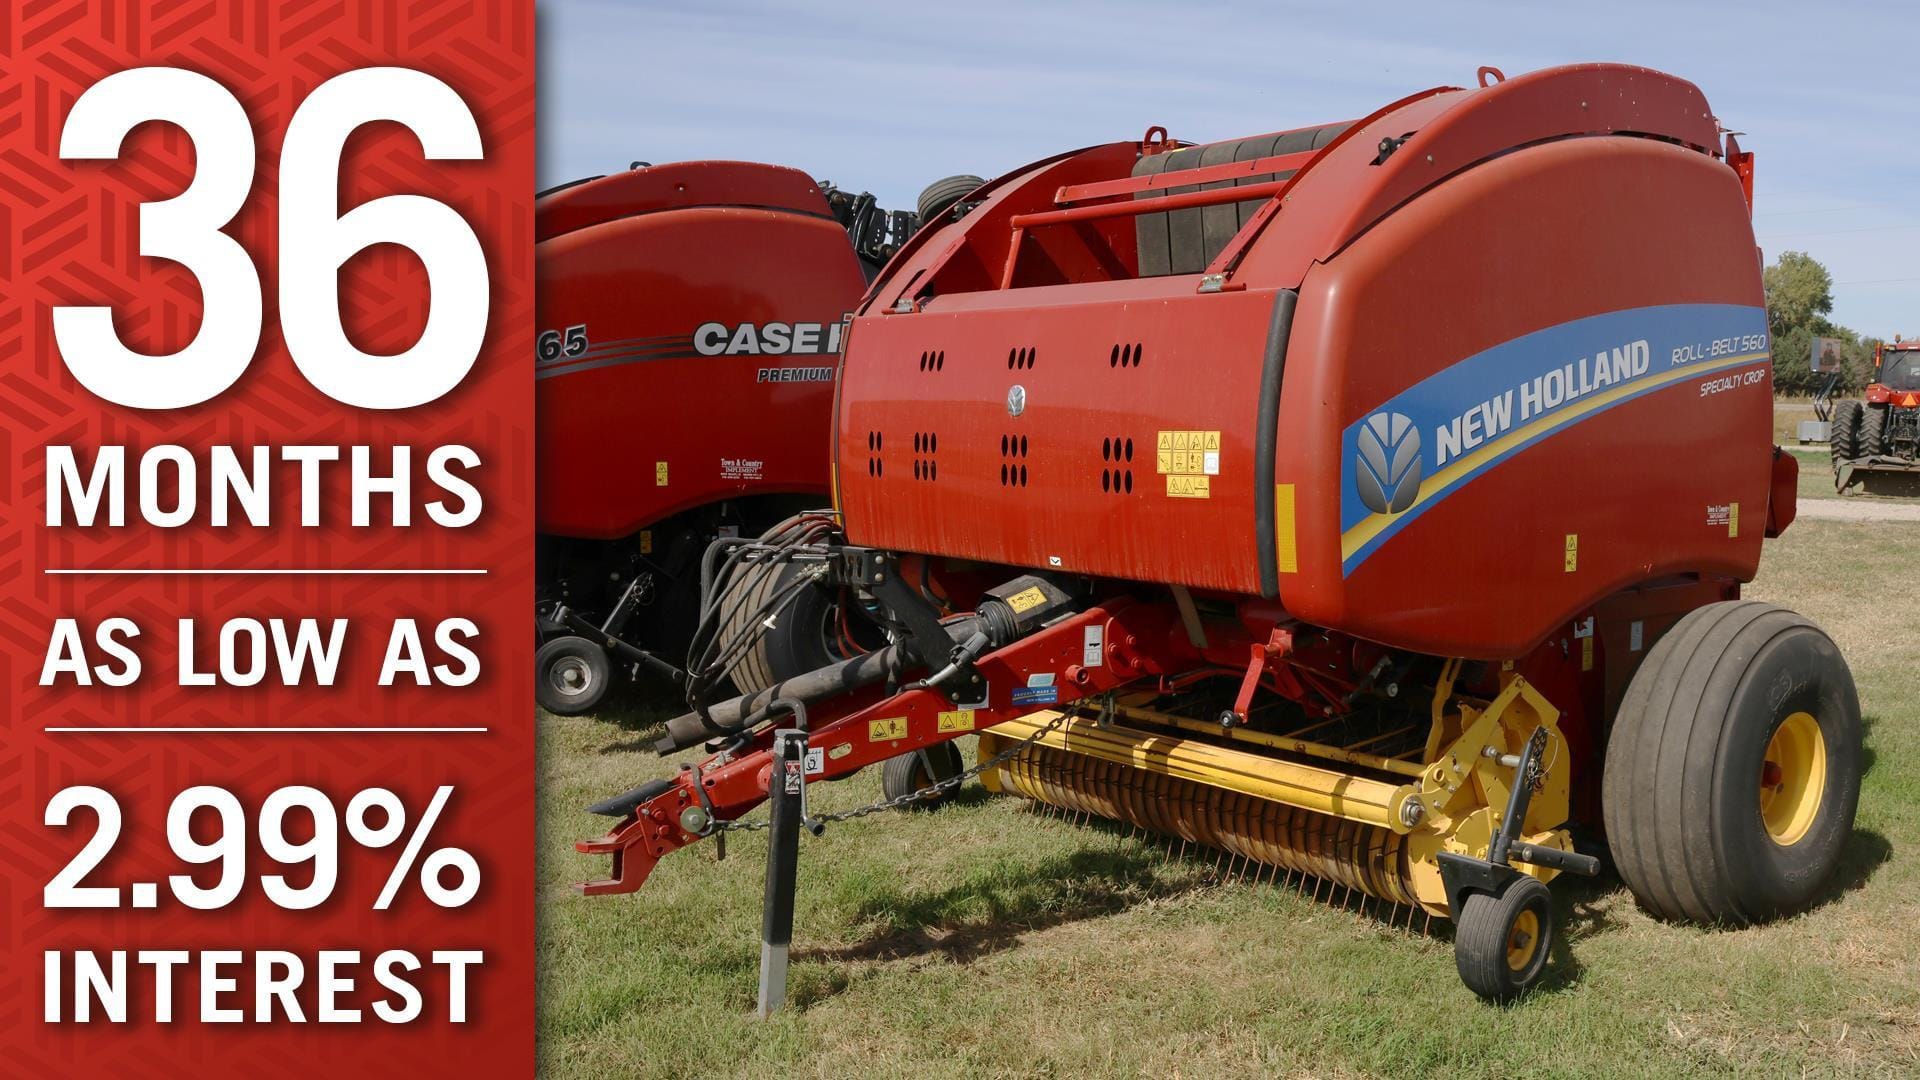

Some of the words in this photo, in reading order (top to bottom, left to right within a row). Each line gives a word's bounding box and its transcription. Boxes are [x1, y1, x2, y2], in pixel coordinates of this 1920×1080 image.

[694, 322, 821, 355] CASE
[1741, 334, 1766, 351] 560
[757, 366, 833, 383] PREMIUM
[1700, 373, 1743, 397] SPECIALTY
[1743, 369, 1765, 385] CROP
[1436, 389, 1514, 466] NEW
[1520, 339, 1650, 421] HOLLAND
